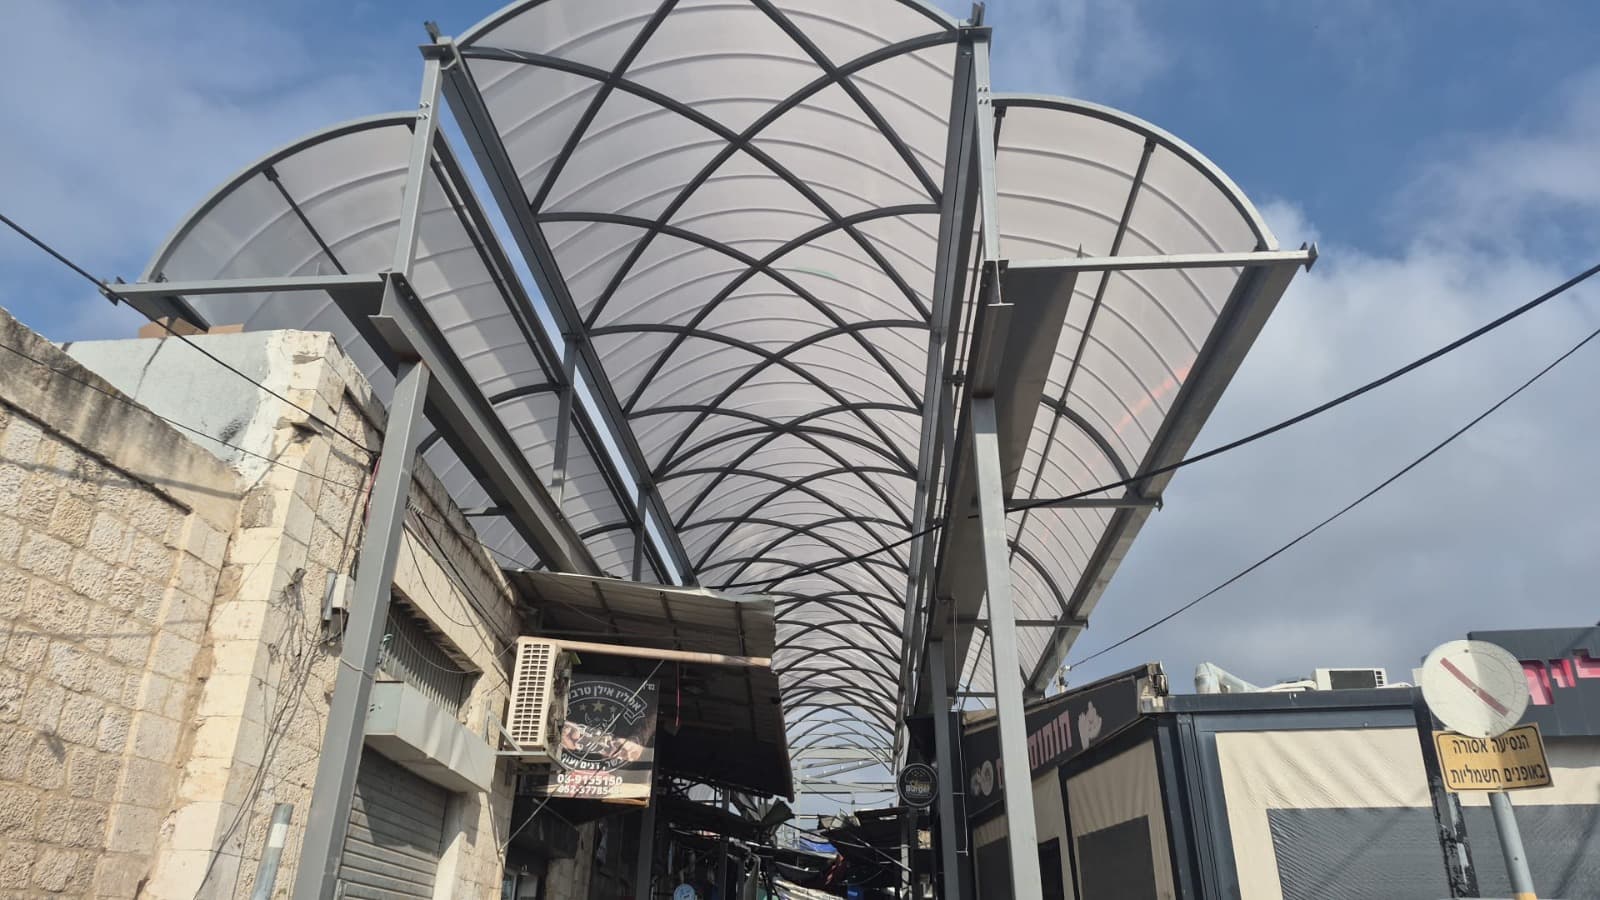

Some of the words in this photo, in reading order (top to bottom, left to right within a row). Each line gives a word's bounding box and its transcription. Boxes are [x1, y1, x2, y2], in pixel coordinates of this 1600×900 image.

[594, 685, 615, 697] אילן
[1027, 710, 1072, 770] חומוס
[1452, 739, 1488, 754] אסורה
[1490, 735, 1530, 753] הנסיעה
[562, 753, 579, 767] ועוף
[580, 761, 601, 770] דגים
[1450, 764, 1502, 784] חשמליות
[1504, 764, 1546, 782] באופנים
